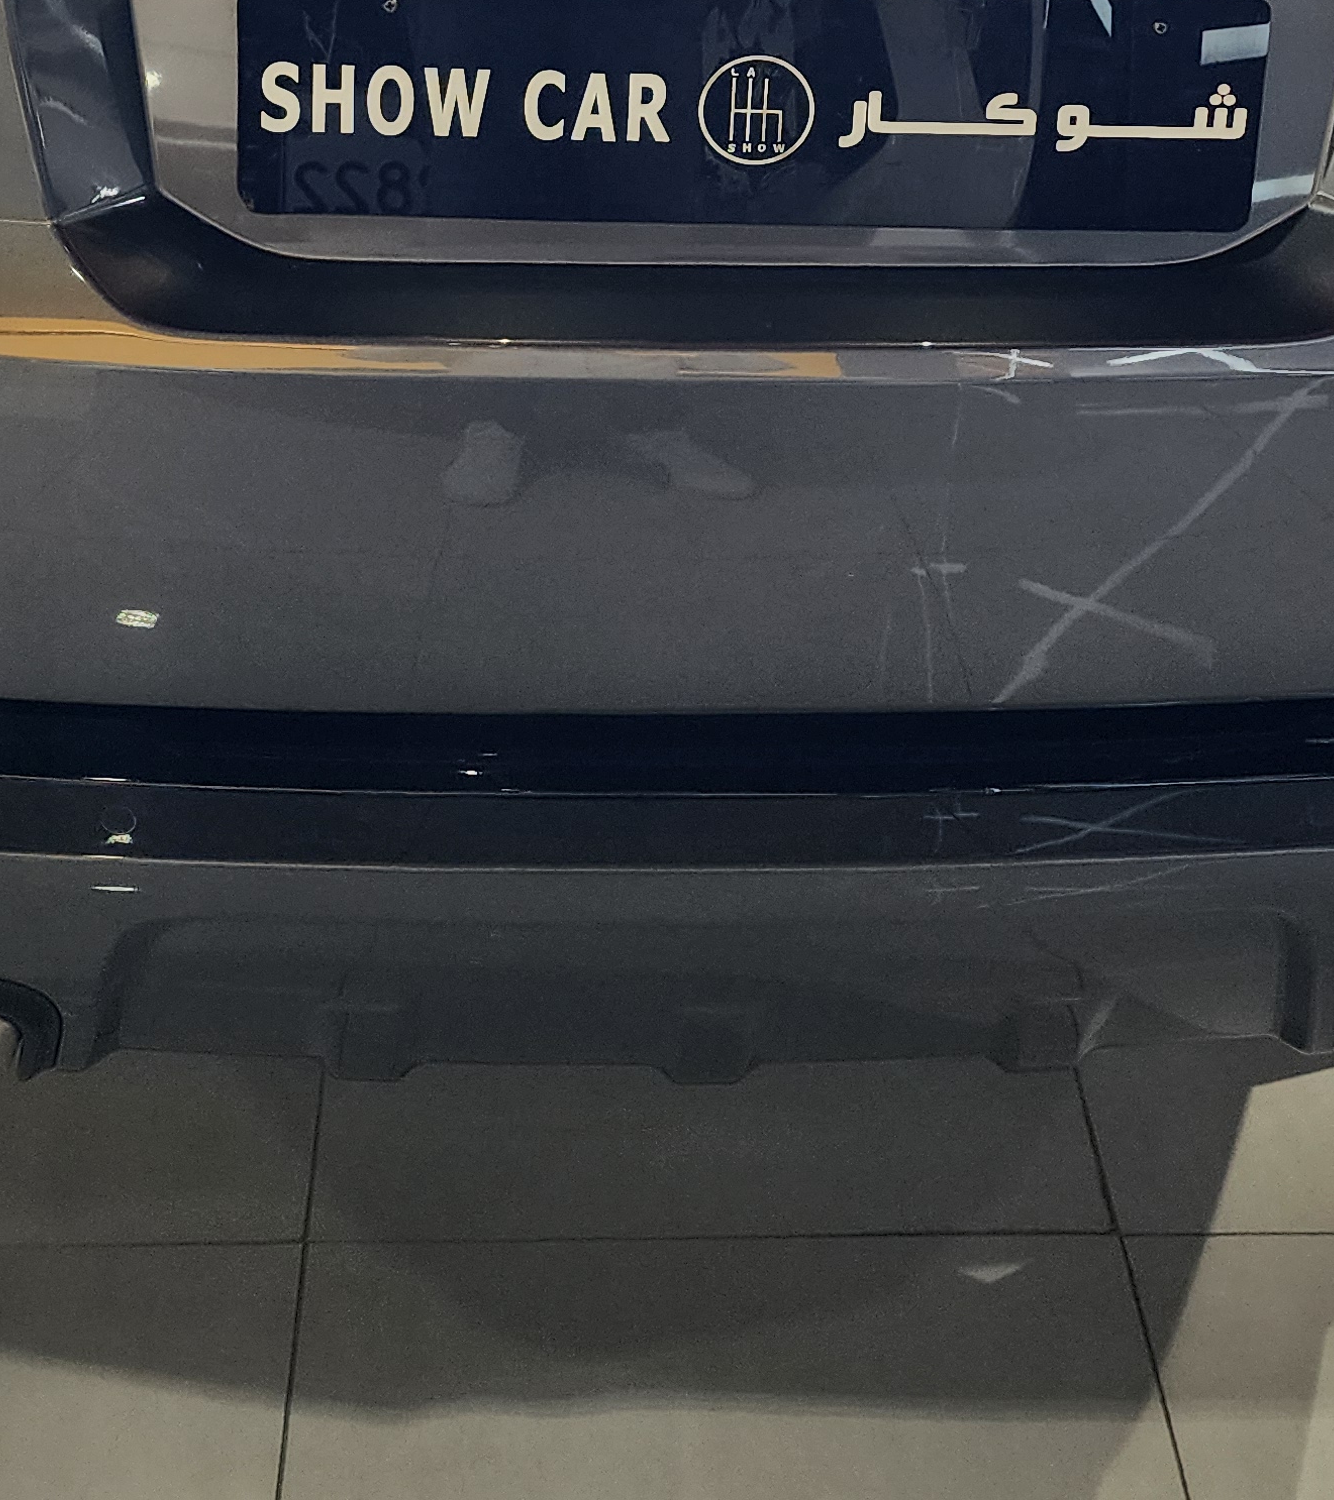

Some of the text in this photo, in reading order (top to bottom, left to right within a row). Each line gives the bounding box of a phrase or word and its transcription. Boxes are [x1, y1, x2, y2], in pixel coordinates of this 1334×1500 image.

[260, 60, 671, 143] SHOW CAR
[727, 142, 786, 153] SHOW
